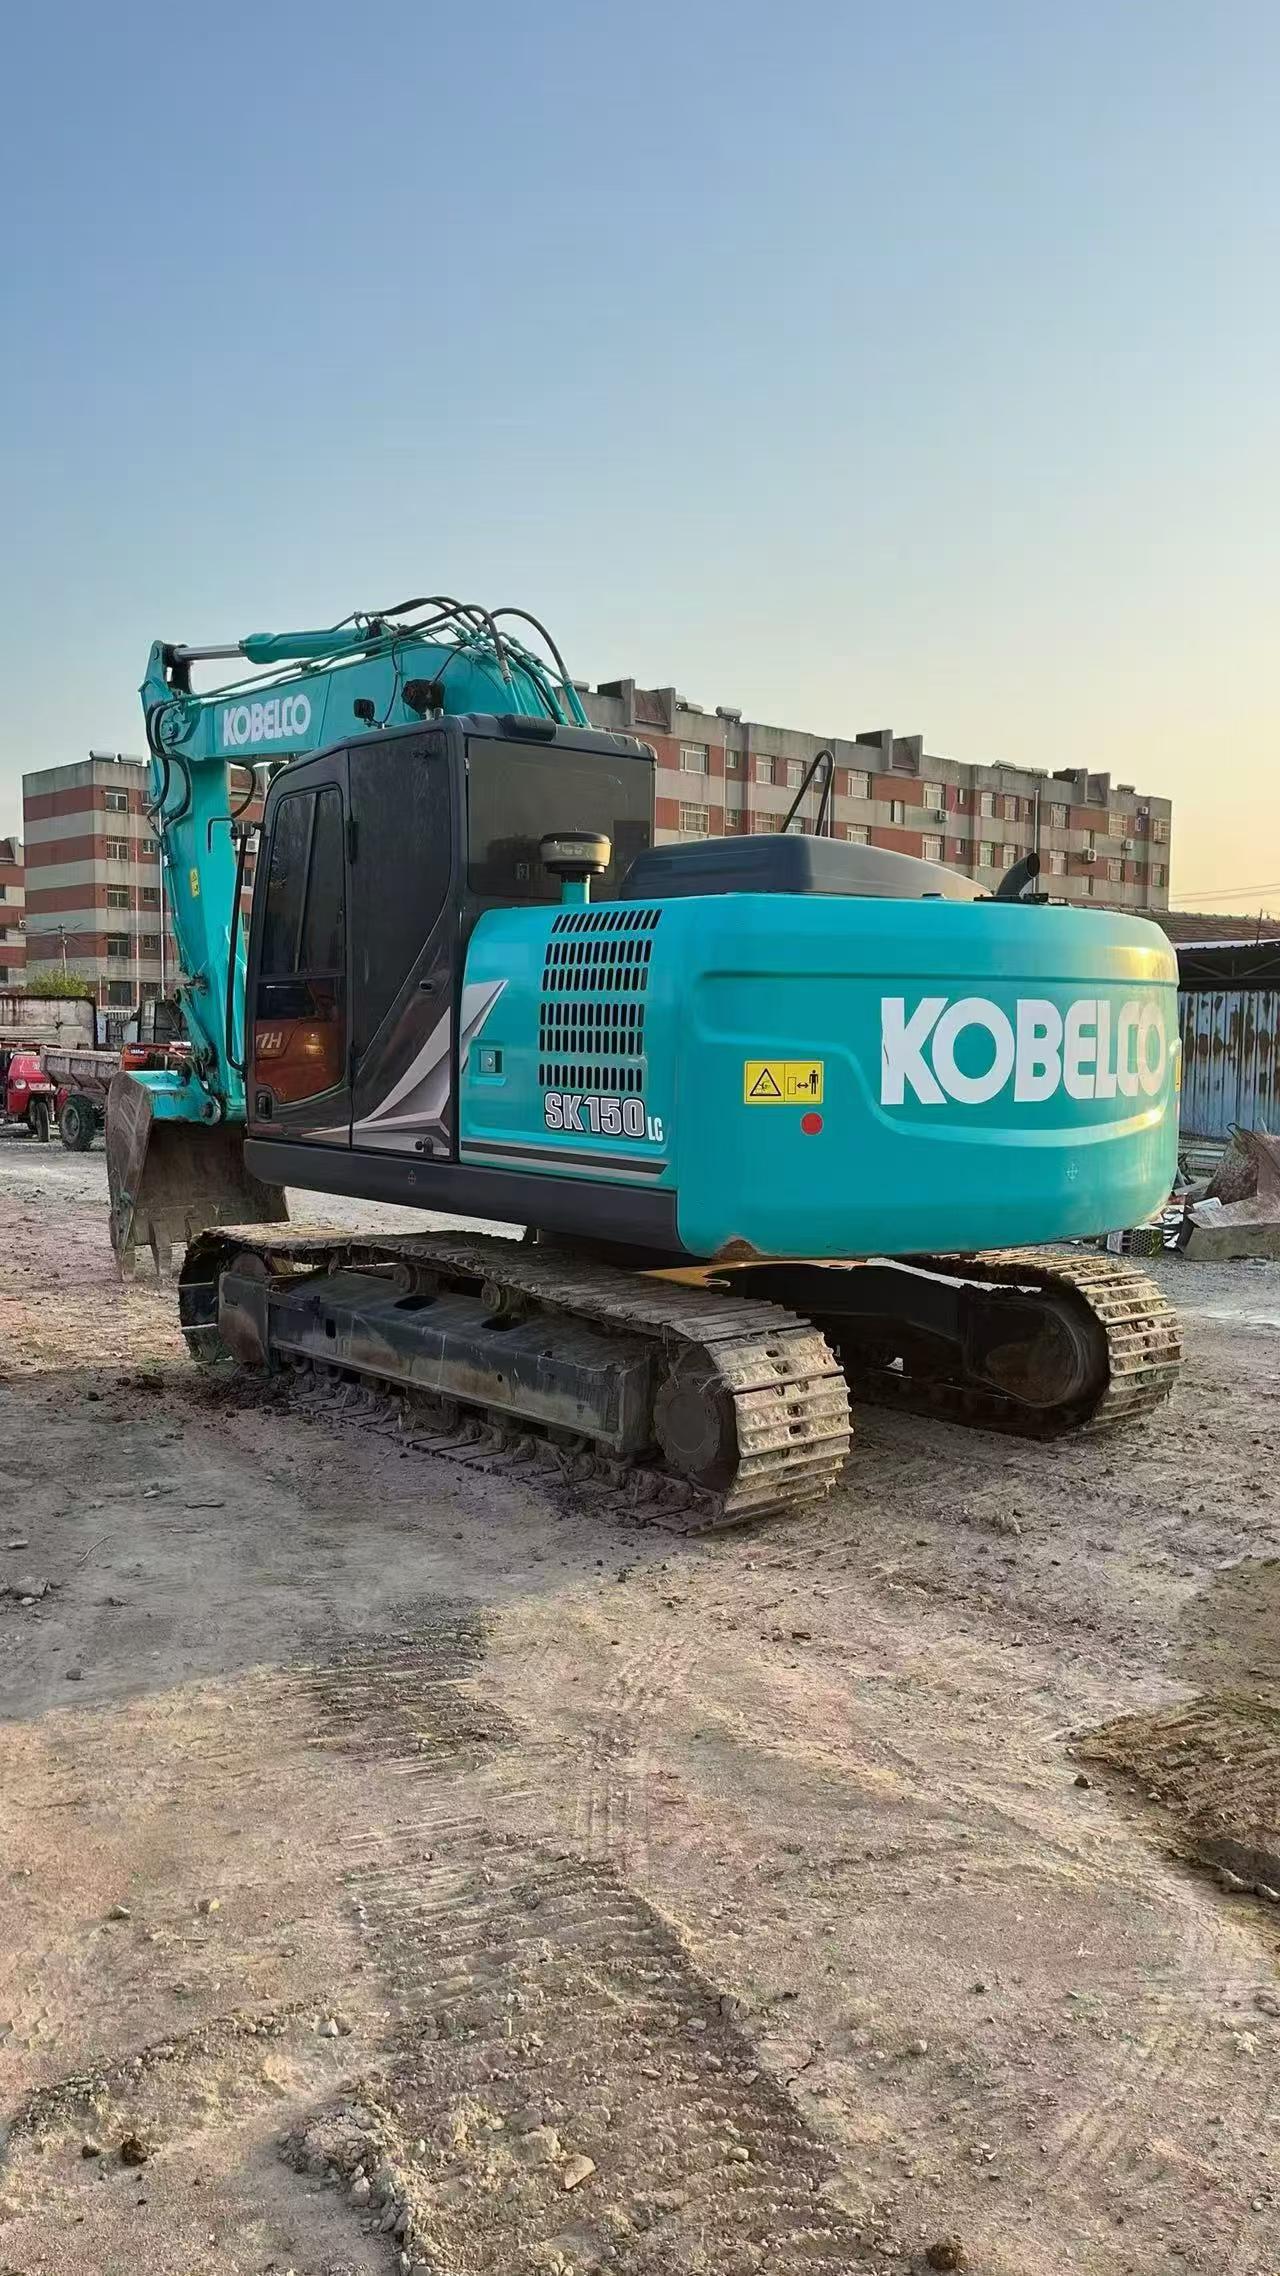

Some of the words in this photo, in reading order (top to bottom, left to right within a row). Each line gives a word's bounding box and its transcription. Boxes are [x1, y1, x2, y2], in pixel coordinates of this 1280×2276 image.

[223, 694, 311, 747] KOBELCO
[880, 997, 1165, 1105] KOBELCO
[544, 1091, 646, 1138] SK150
[647, 1116, 664, 1142] LC
